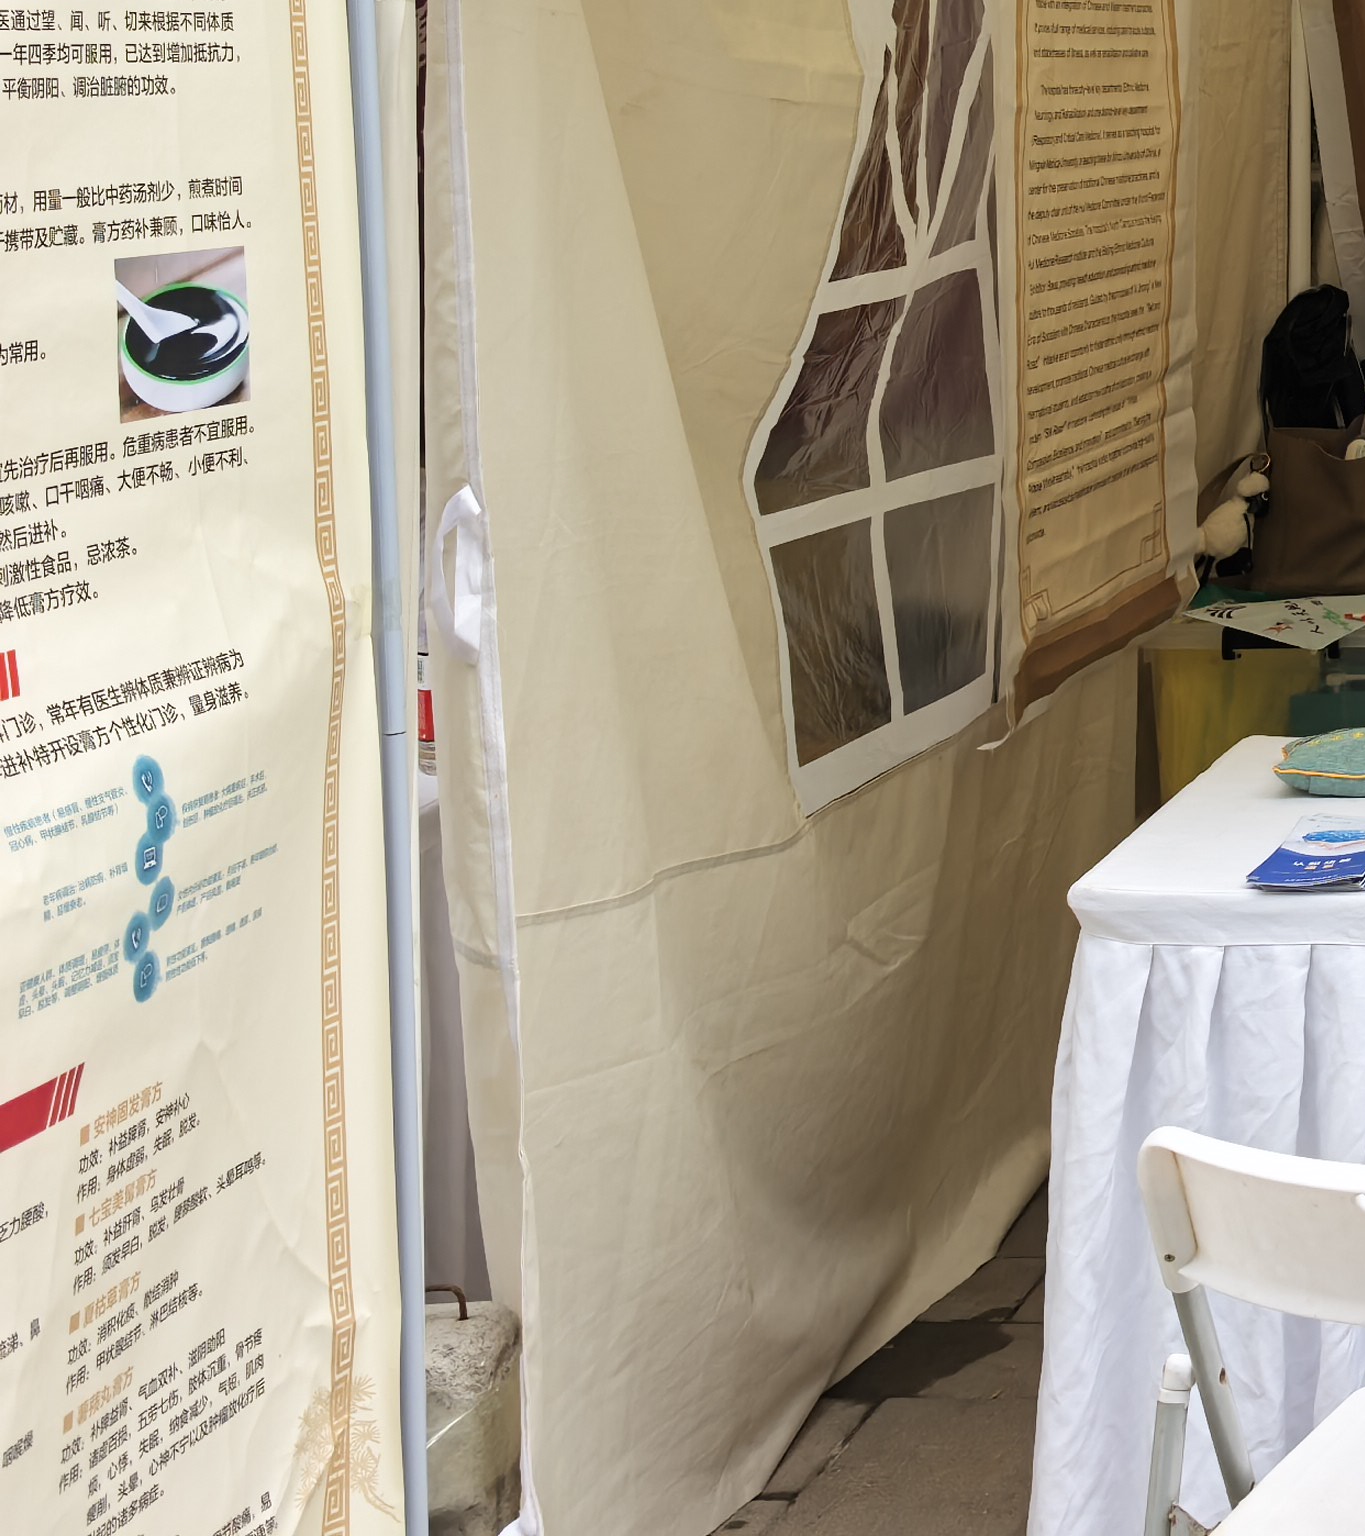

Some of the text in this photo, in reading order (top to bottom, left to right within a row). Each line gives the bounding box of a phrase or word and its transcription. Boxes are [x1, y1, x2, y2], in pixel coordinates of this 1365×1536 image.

[0, 176, 243, 215] 材，用量一般比中药汤剂少，煎煮时间
[0, 213, 252, 252] 携带及贮藏。膏方药补兼顾，口味怡人。
